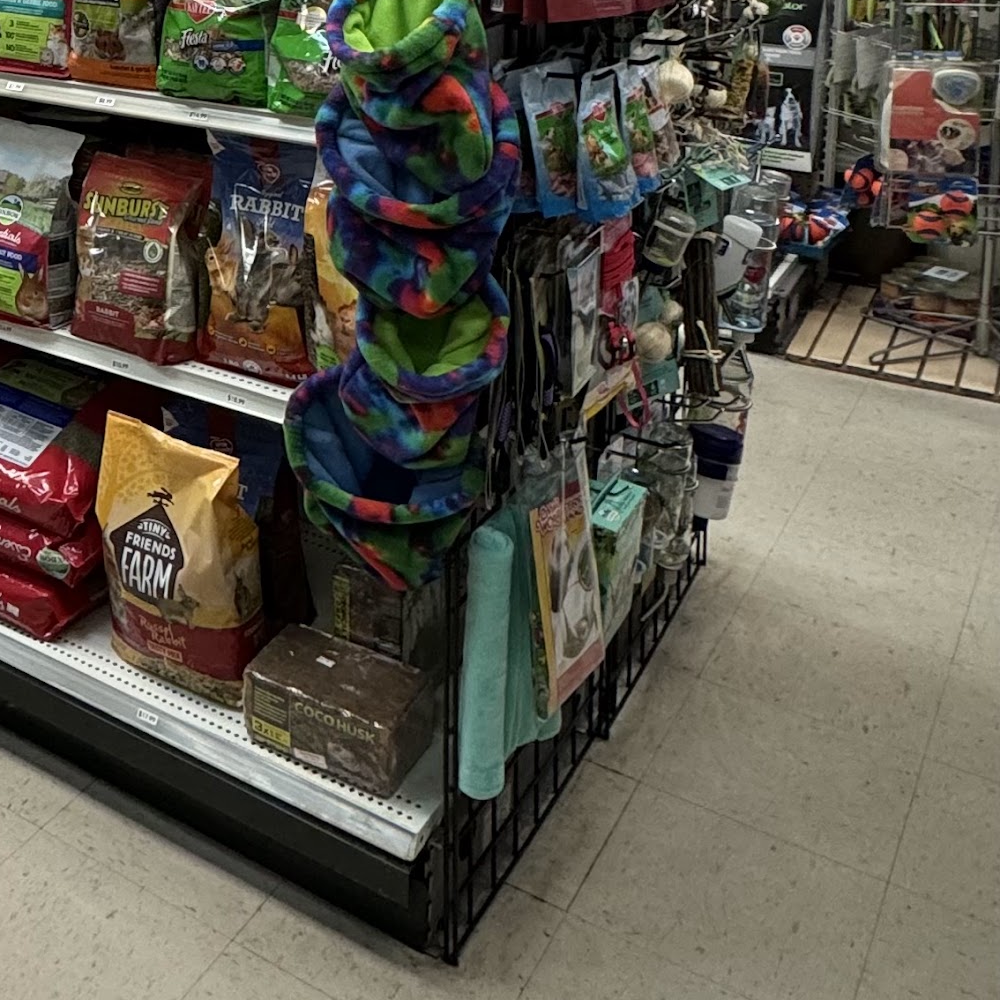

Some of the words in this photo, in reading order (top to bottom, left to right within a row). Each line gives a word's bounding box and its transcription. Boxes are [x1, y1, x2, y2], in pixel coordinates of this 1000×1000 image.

[179, 28, 209, 49] Fiesta
[83, 190, 169, 221] SUNBURST
[230, 194, 306, 223] RABBIT
[7, 250, 23, 261] FOOD
[95, 305, 120, 317] RABBIT
[142, 521, 167, 537] TINY
[125, 531, 177, 561] FRIENDS
[121, 546, 173, 600] FARM
[293, 702, 335, 727] COCO
[336, 719, 377, 745] HUSK
